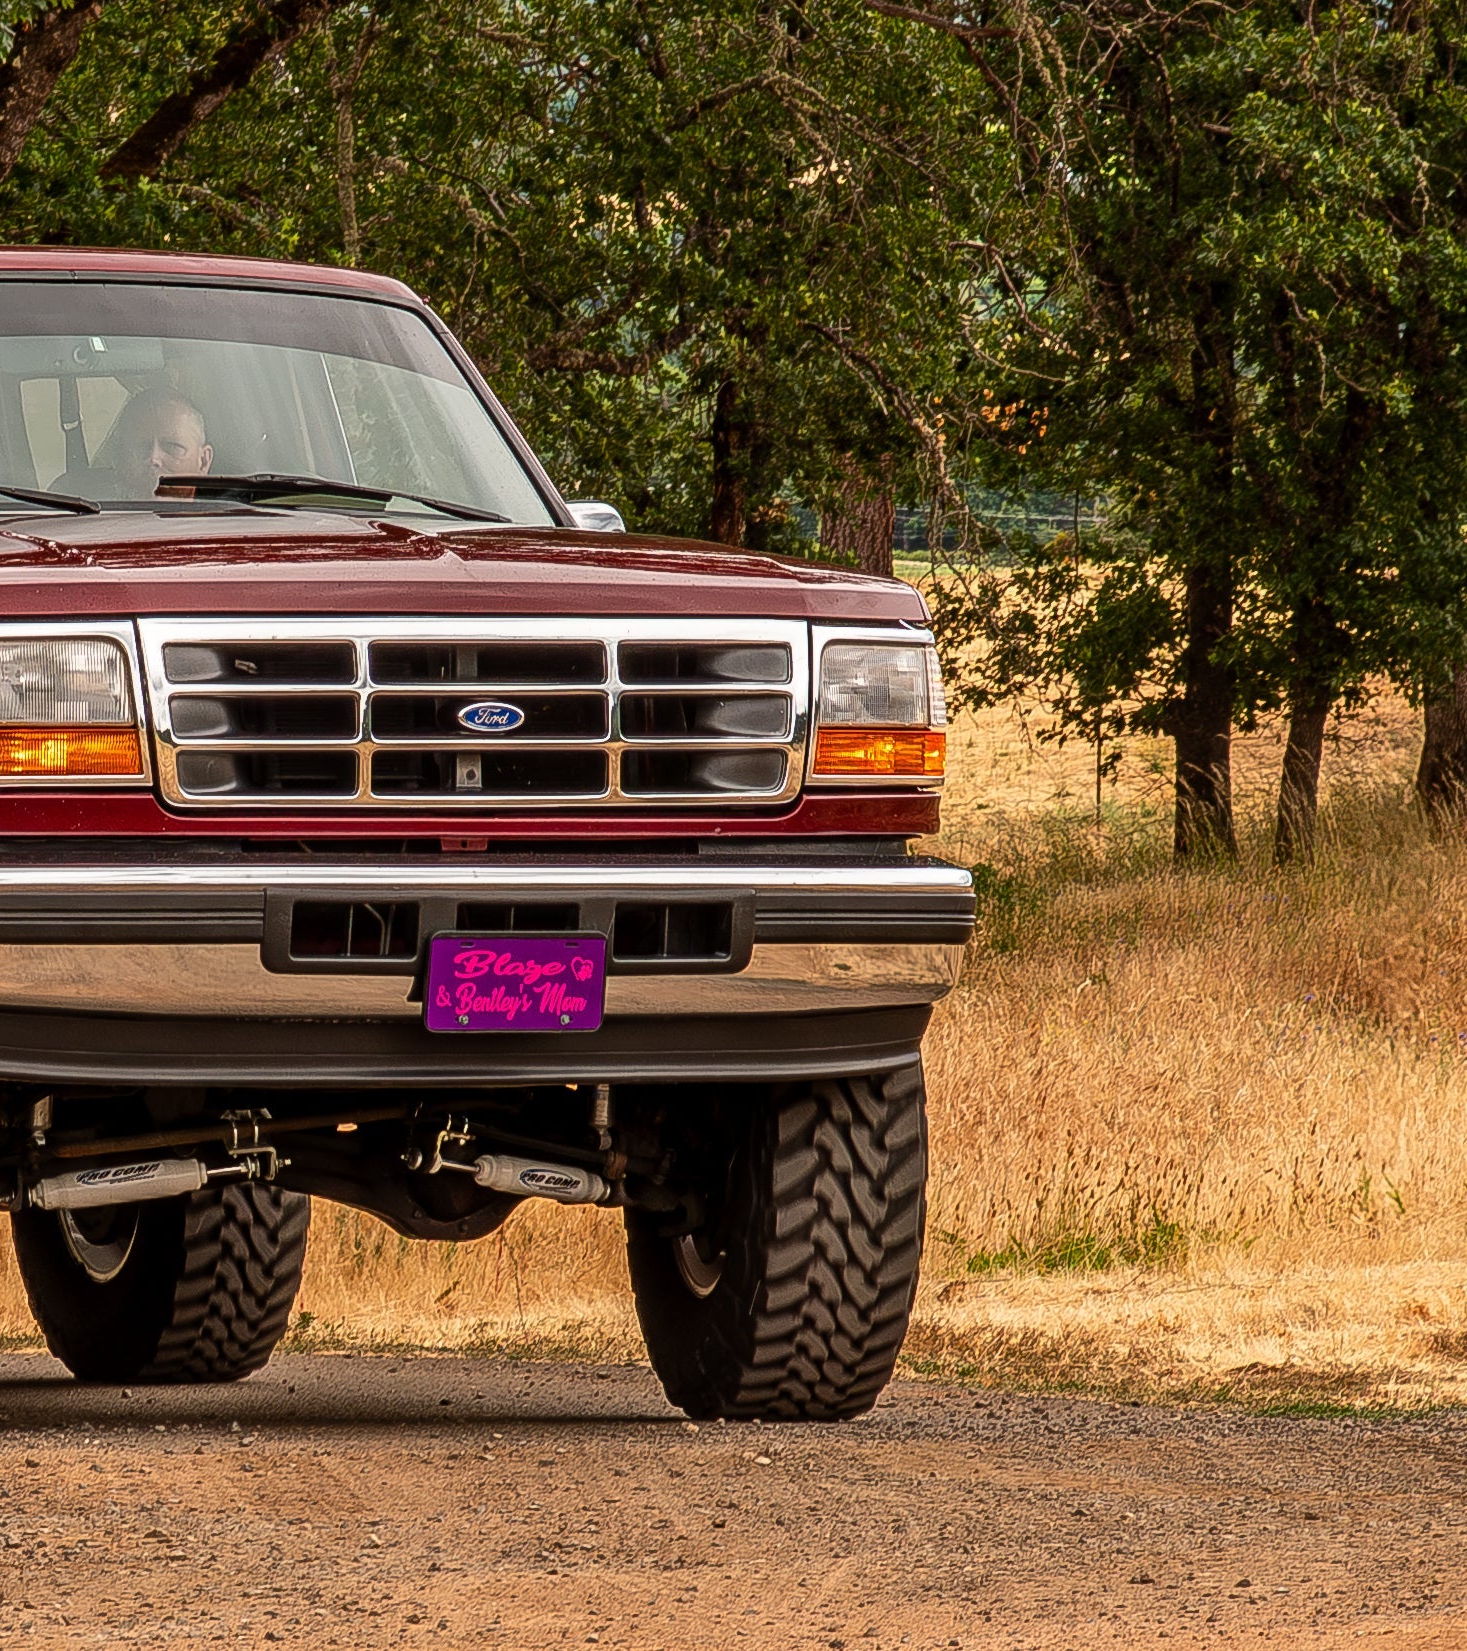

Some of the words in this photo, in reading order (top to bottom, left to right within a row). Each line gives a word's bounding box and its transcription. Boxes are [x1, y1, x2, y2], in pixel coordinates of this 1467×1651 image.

[474, 707, 510, 725] Ford
[453, 950, 566, 984] Blaze
[435, 984, 452, 1007] &
[455, 982, 532, 1020] Bentley's
[533, 981, 587, 1016] Mom
[76, 1170, 112, 1183] PRO
[112, 1163, 161, 1177] COMP
[520, 1172, 546, 1184] PRO
[544, 1176, 581, 1189] COMP
